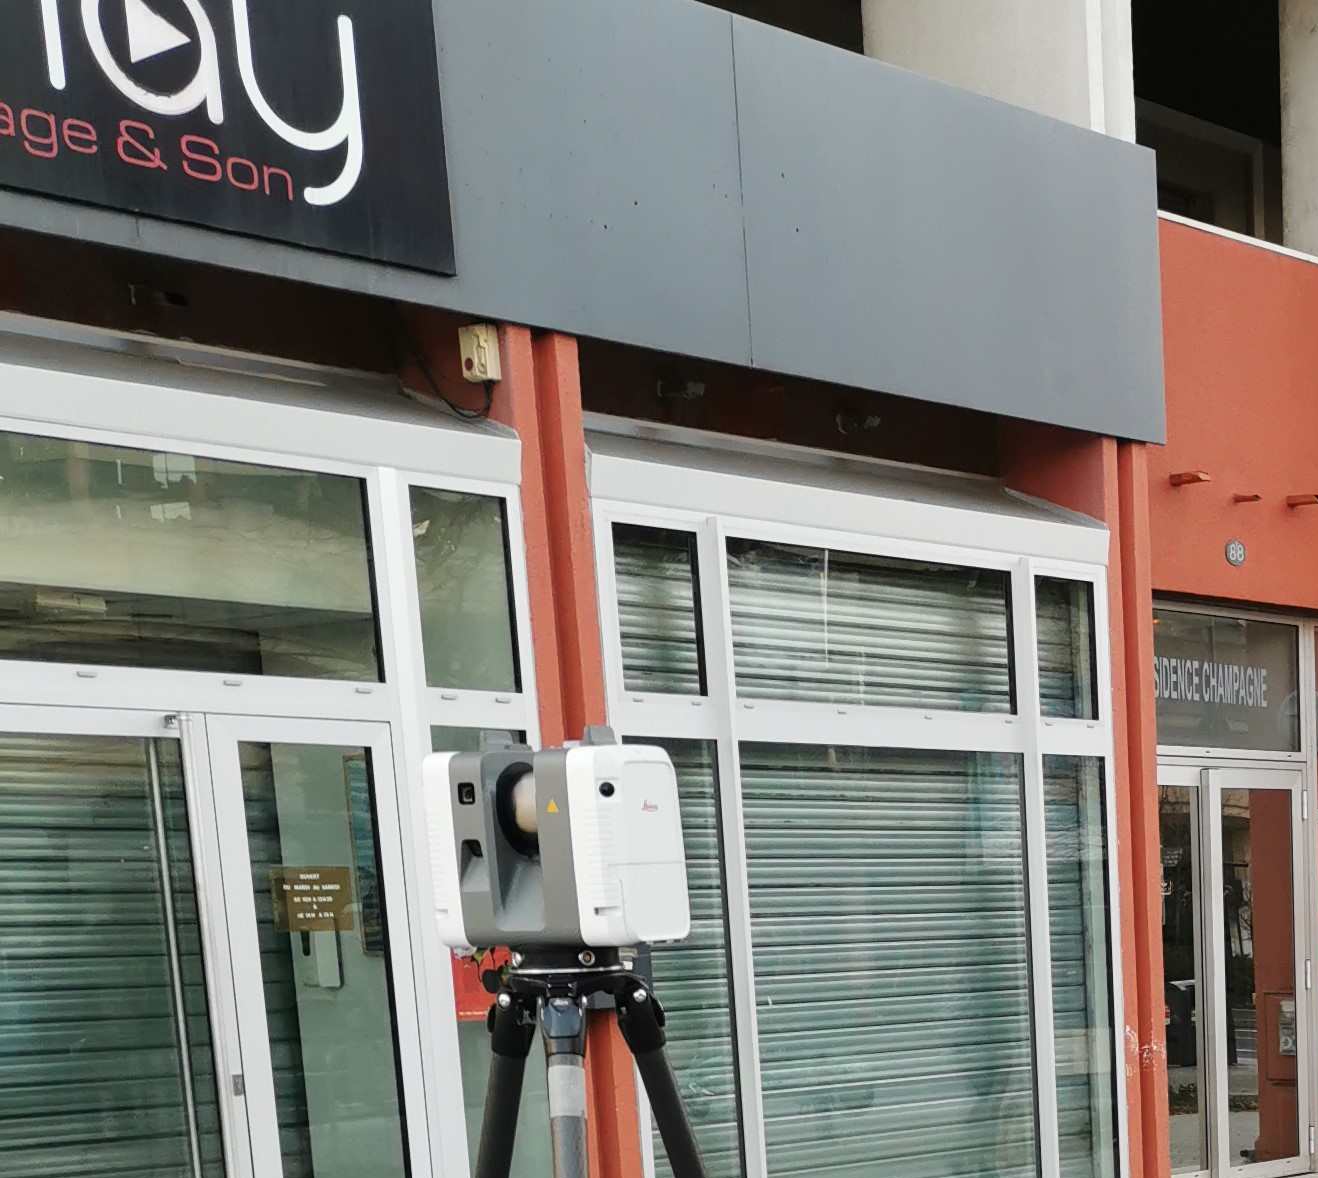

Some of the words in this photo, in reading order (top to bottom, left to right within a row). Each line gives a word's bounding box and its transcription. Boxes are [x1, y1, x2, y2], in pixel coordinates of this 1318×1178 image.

[116, 119, 168, 171] &
[180, 134, 293, 201] Son
[1230, 543, 1245, 562] 88
[1202, 661, 1268, 708] CHAMPAGNE
